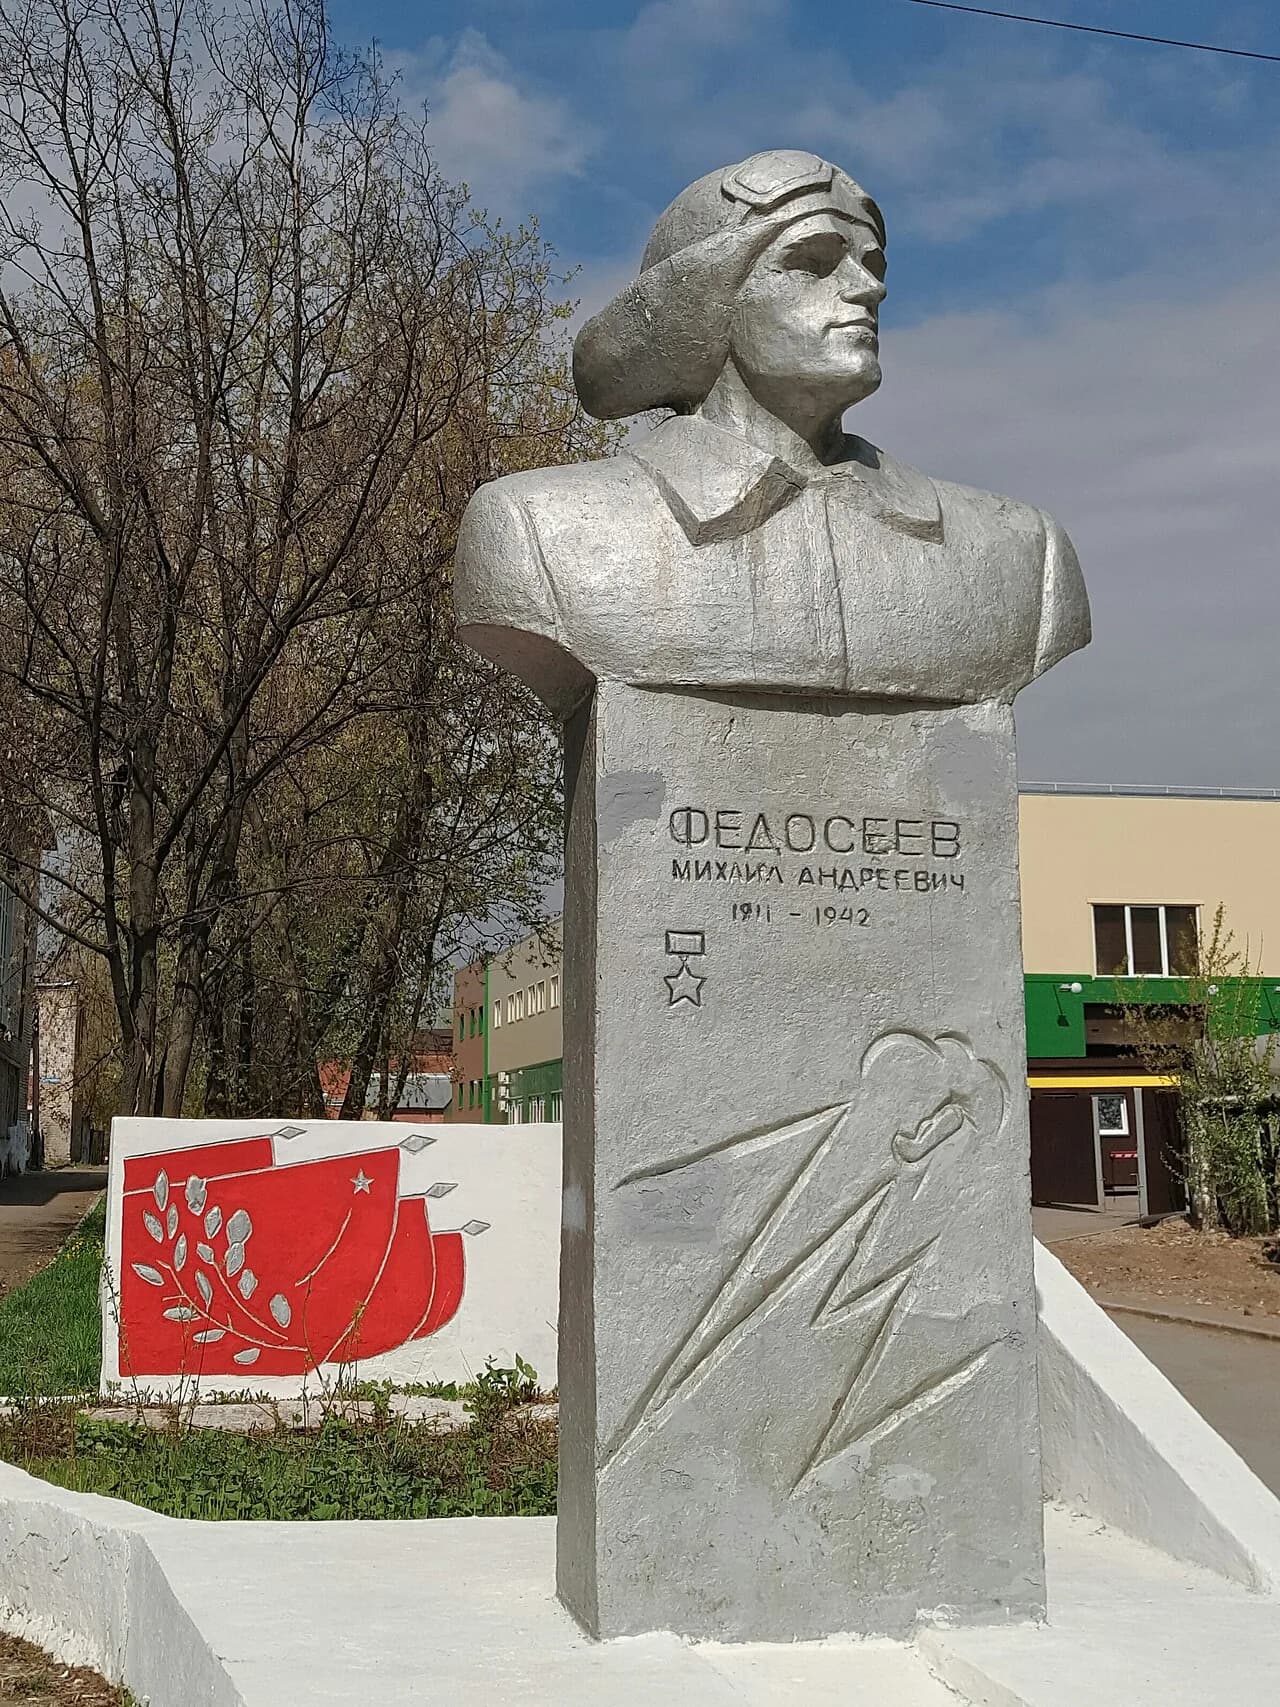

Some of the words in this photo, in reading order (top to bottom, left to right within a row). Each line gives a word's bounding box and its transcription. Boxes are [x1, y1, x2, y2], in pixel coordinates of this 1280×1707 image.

[669, 807, 962, 857] ФЕДОСЕЕВ
[672, 858, 784, 884] МИХАИЛ
[797, 866, 966, 893] АНДРЕЕВИЧ
[732, 902, 772, 924] 1911
[815, 906, 872, 928] 1942
